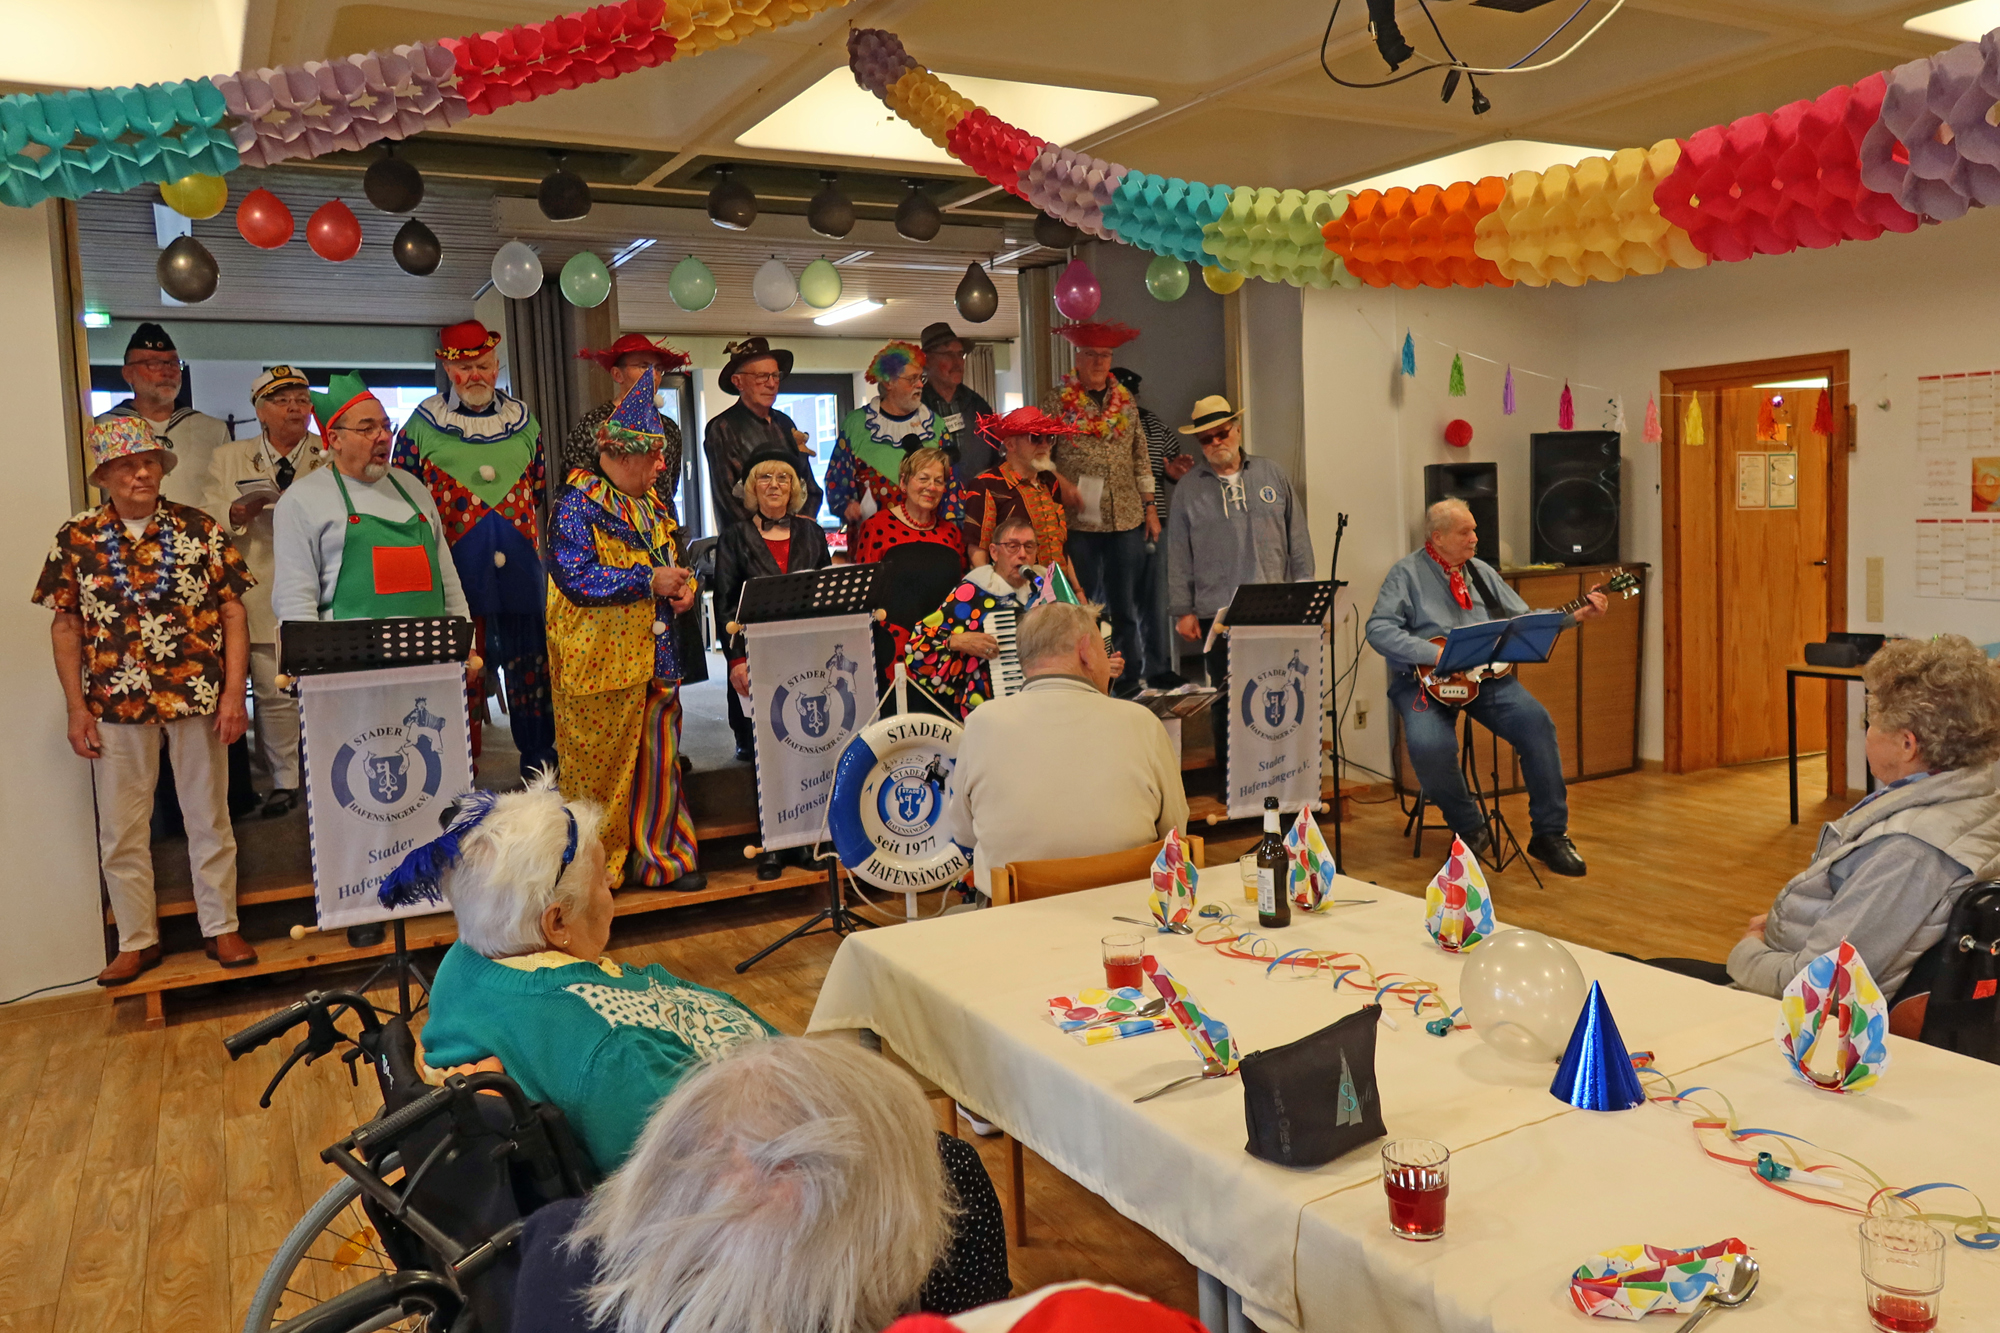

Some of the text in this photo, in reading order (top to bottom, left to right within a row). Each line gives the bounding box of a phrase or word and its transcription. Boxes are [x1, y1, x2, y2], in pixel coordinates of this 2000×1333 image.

[787, 670, 826, 687] STADER
[1257, 669, 1287, 682] STADER
[354, 727, 403, 746] STADER
[784, 730, 847, 754] HAFENSÄNGER e.V.
[887, 722, 953, 744] STADER
[1258, 755, 1286, 772] Stader
[893, 769, 927, 781] STADER
[349, 794, 429, 823] HAFENSÄNGER e.V.
[368, 838, 415, 864] Stader
[875, 834, 936, 856] seit 1977
[866, 856, 964, 887] HAFENSÄNGER
